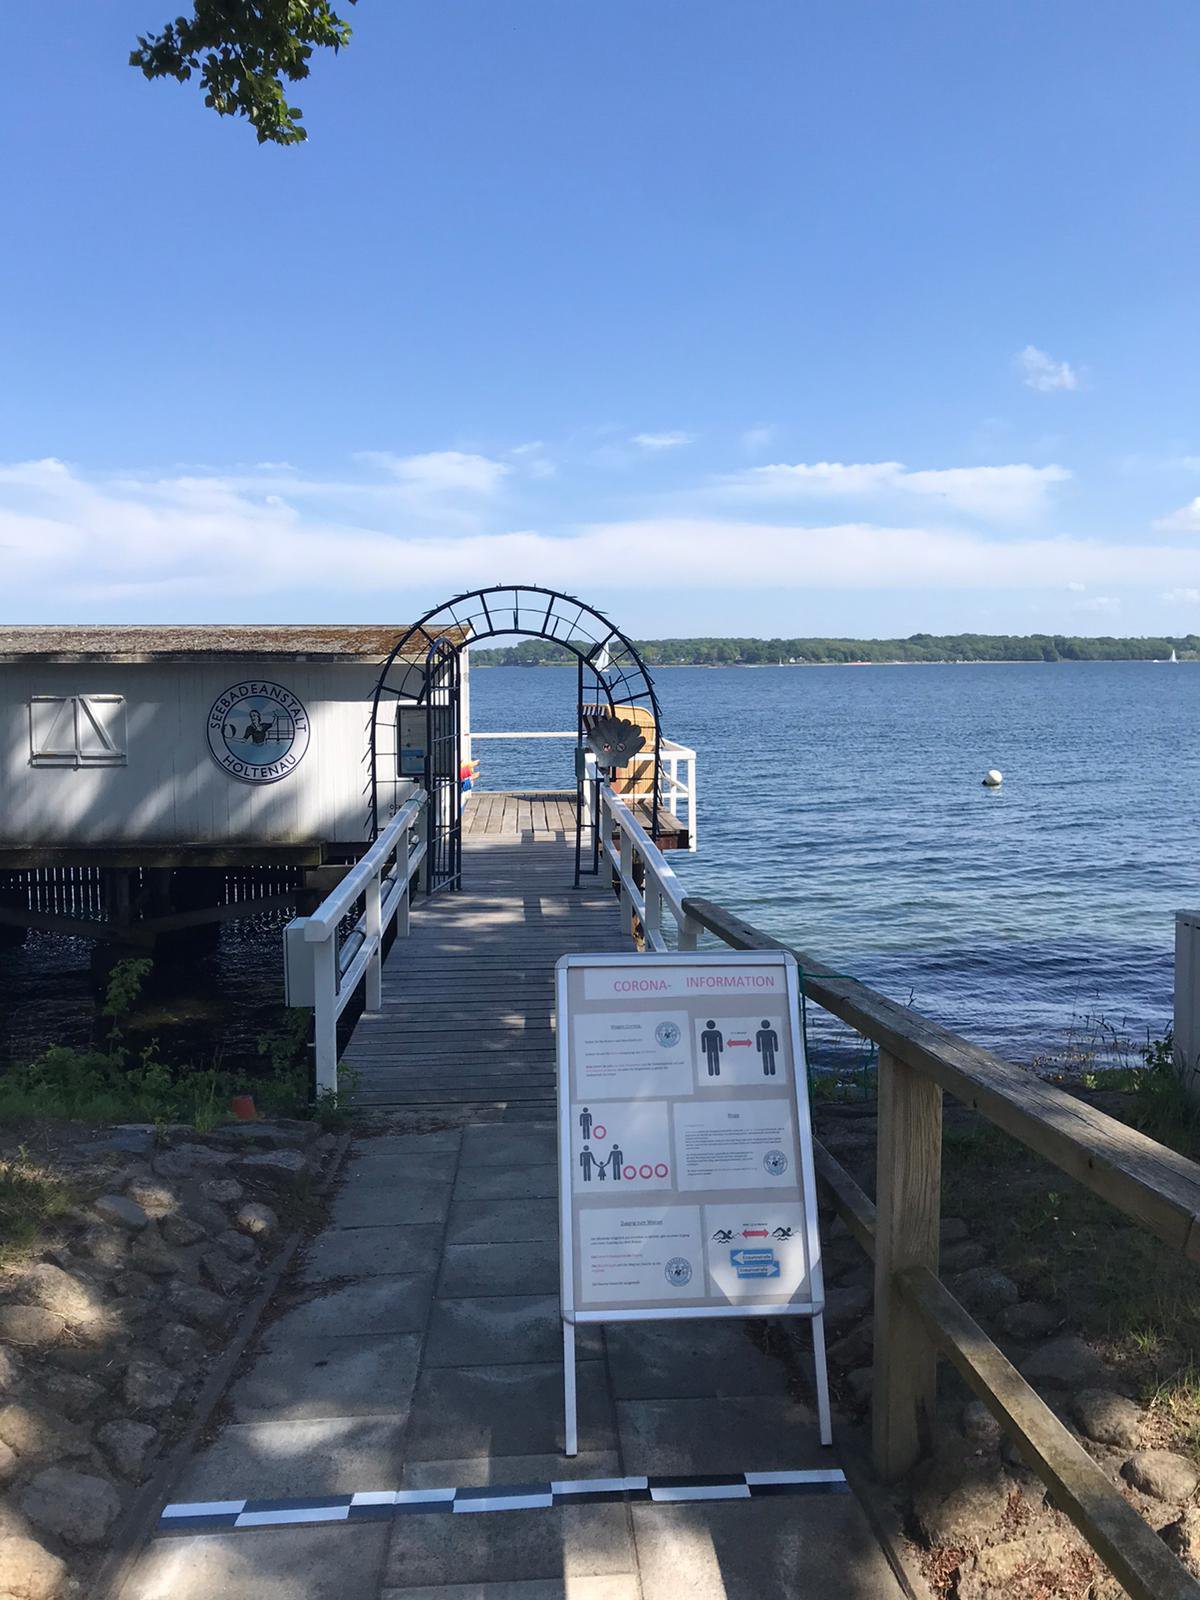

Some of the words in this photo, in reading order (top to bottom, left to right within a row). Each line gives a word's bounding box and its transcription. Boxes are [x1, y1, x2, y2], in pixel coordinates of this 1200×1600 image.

[210, 684, 307, 733] SEEBADEANSTALT
[222, 753, 297, 778] HOLTENAU
[613, 980, 672, 993] CORONA-
[686, 976, 775, 988] INFORMATION
